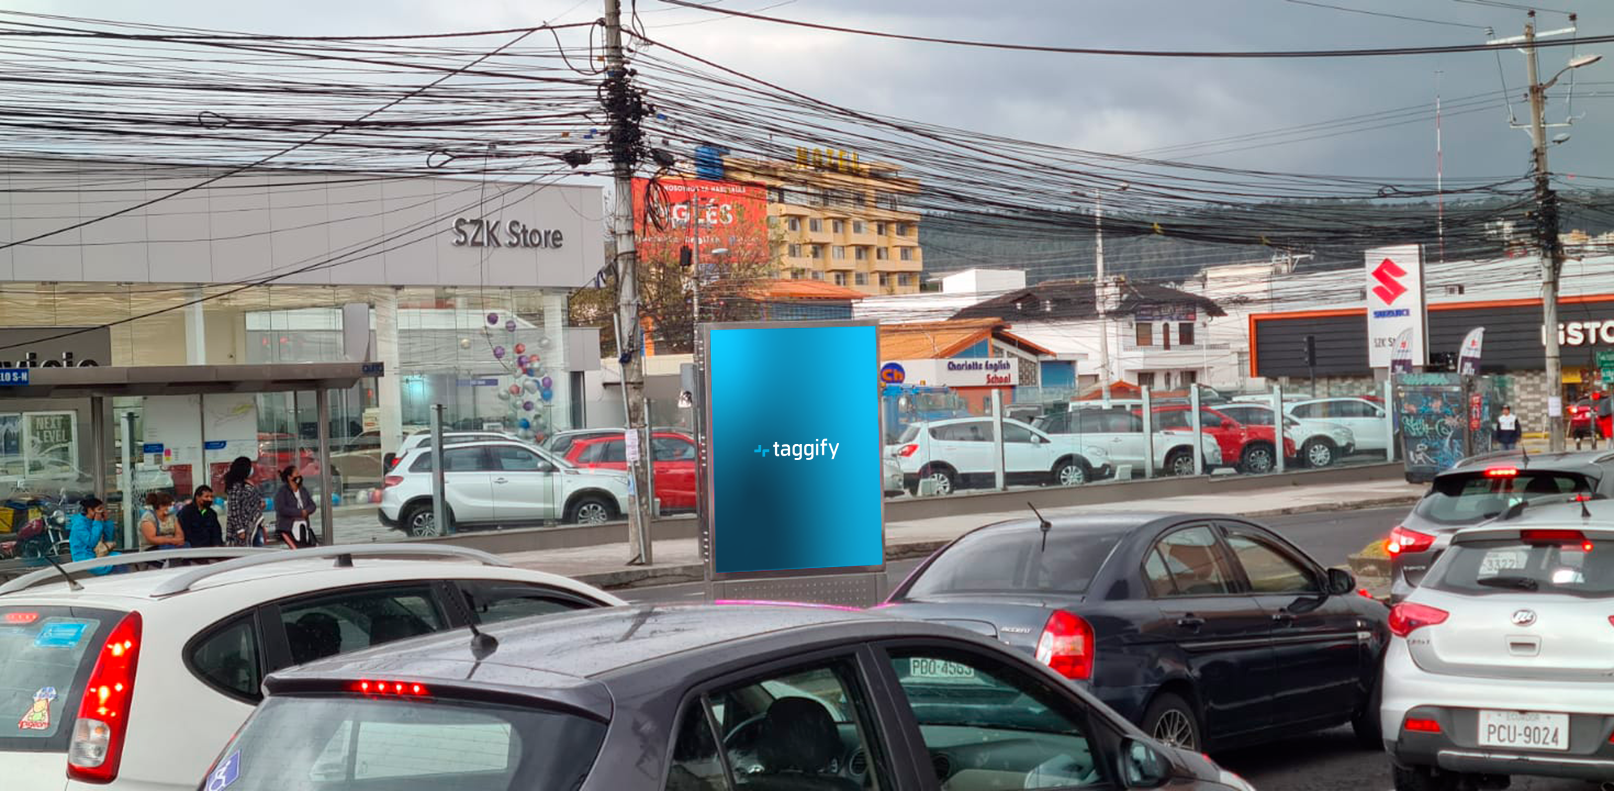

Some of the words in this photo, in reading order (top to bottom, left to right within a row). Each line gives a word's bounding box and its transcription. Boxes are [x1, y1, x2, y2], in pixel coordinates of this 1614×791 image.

[452, 218, 501, 247] SZK
[505, 220, 563, 248] Store
[985, 359, 1010, 372] English
[882, 369, 904, 381] Ch
[986, 374, 1011, 384] School
[36, 416, 63, 430] NEXT
[37, 430, 68, 443] LEVEL
[773, 438, 840, 460] taggify
[1487, 723, 1559, 746] PCU-9024
